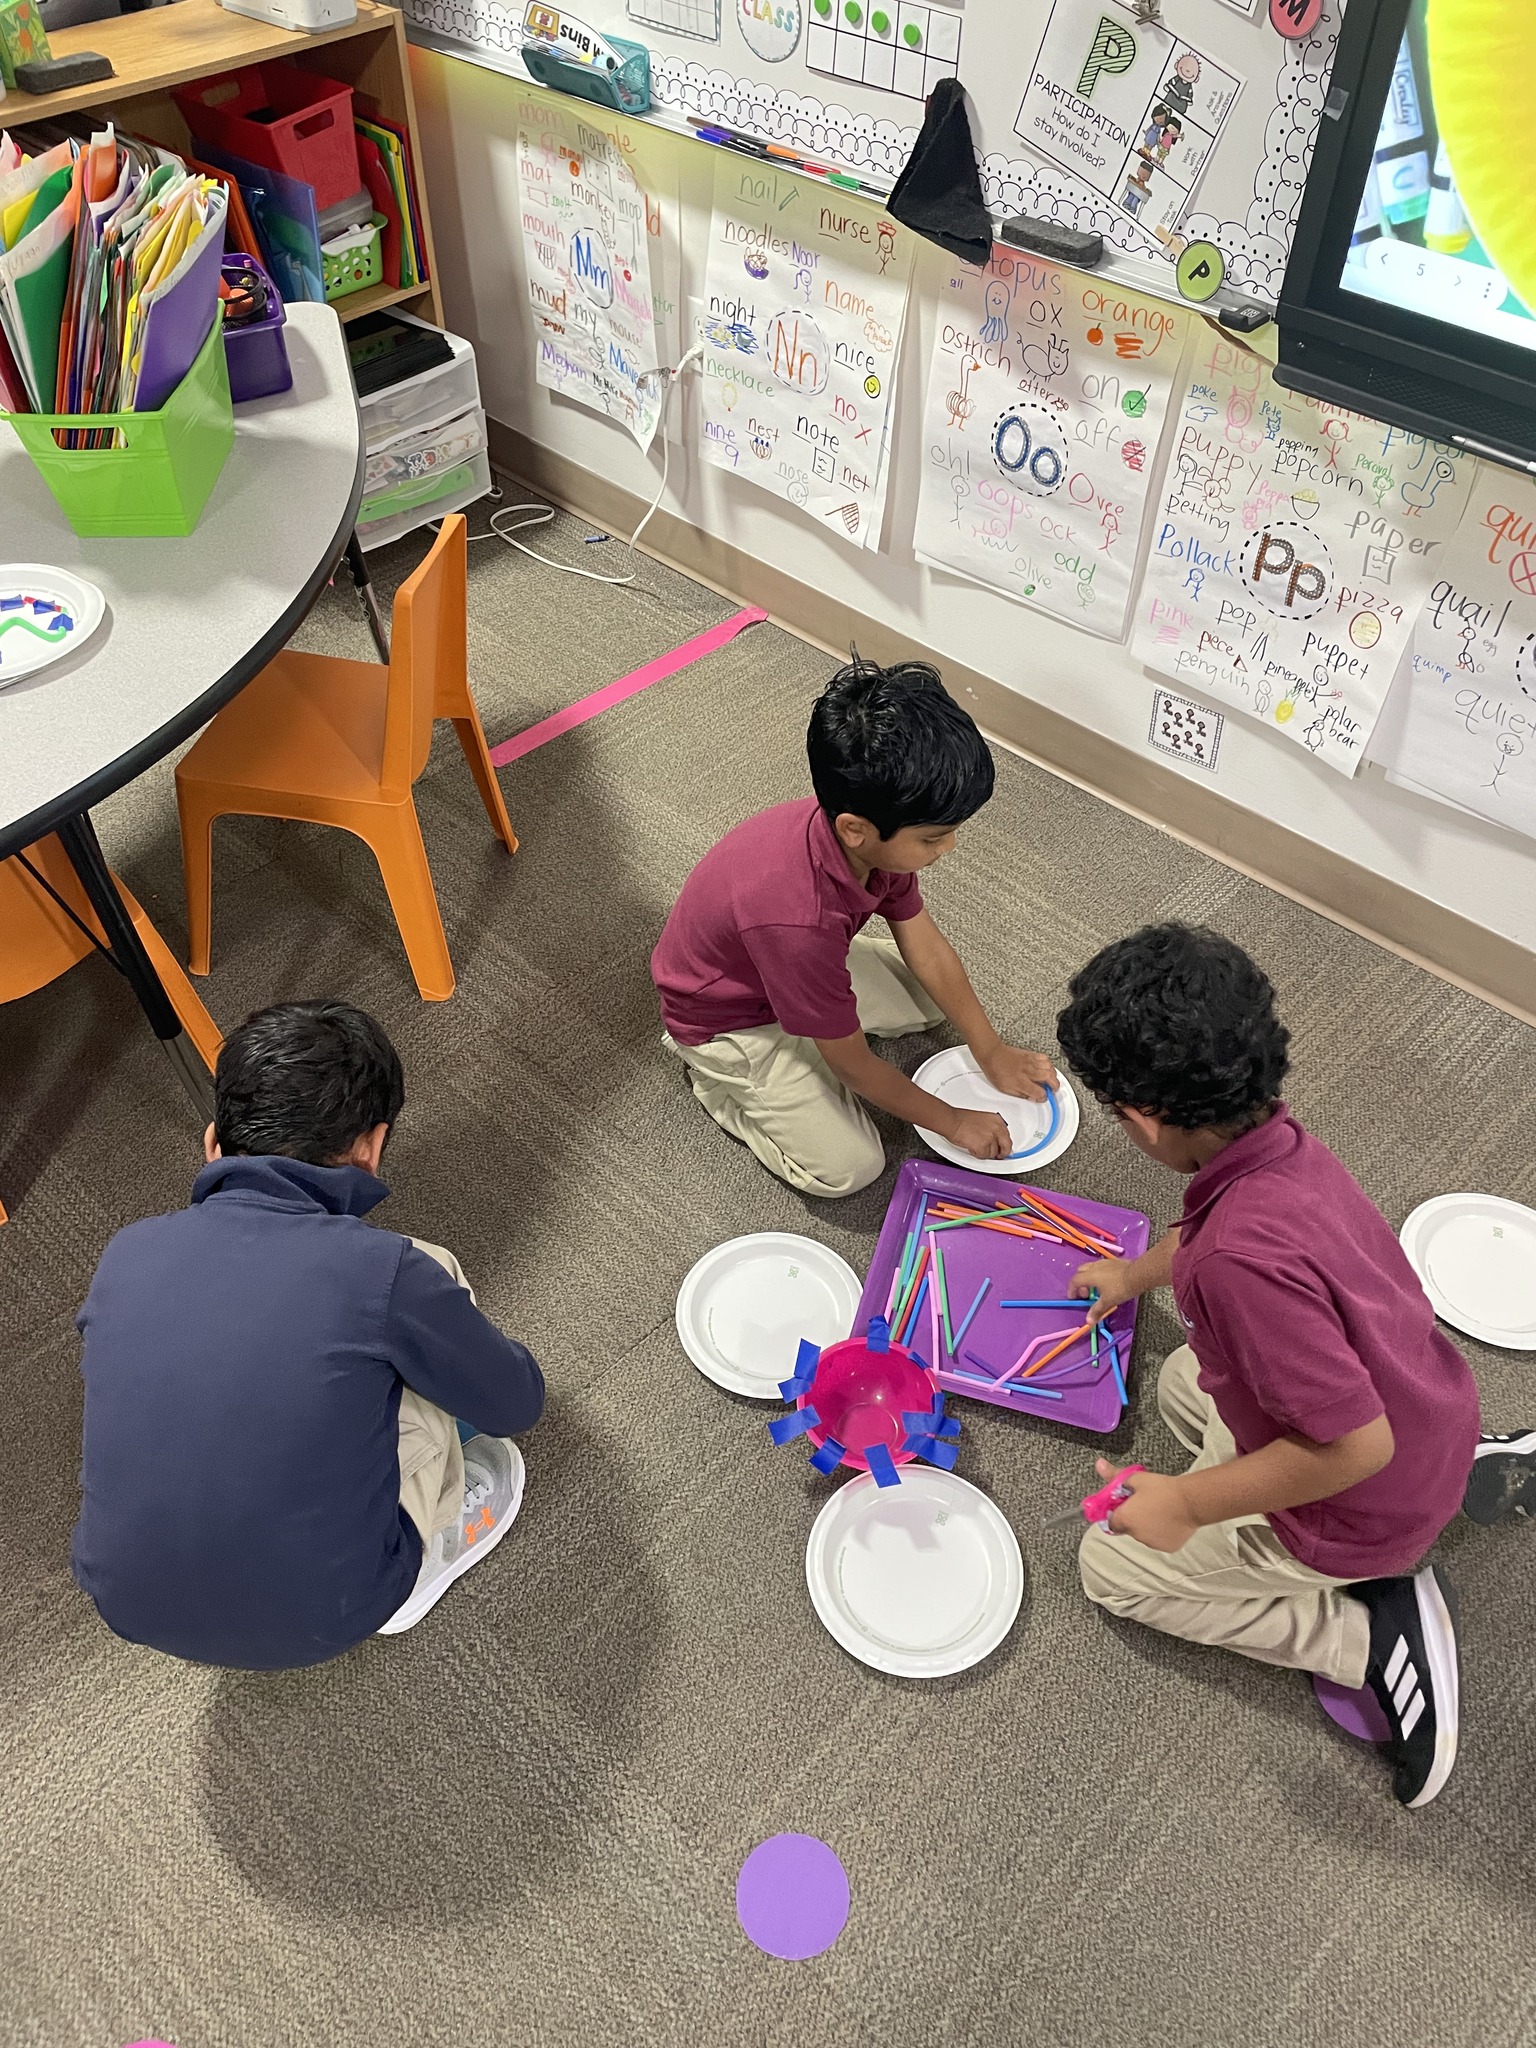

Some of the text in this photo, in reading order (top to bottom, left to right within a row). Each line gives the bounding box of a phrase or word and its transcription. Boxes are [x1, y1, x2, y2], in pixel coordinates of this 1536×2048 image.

[560, 24, 591, 53] Bins
[1077, 16, 1136, 98] P
[1034, 73, 1130, 148] PARTICIPATION
[1052, 106, 1101, 147] How do I
[1034, 116, 1106, 169] stay involved?
[521, 159, 552, 185] mat
[741, 173, 777, 203] nail
[571, 181, 615, 234] monkey
[619, 197, 642, 245] mop
[820, 207, 871, 244] nurse
[523, 213, 565, 249] mouth
[725, 219, 789, 257] noodles
[575, 235, 612, 289] Mm
[792, 241, 821, 268] Noor
[958, 246, 1061, 297] topus
[1188, 259, 1210, 281] P
[1416, 262, 1425, 276] 5
[530, 278, 567, 320] mud
[710, 295, 757, 327] night
[825, 279, 875, 321] name
[1082, 290, 1177, 357] orange
[542, 339, 587, 382] Meghan
[774, 320, 817, 387] Nn
[835, 342, 875, 374] nice
[707, 356, 776, 398] necklace
[1019, 379, 1054, 402] otter
[1082, 374, 1120, 407] on
[1191, 384, 1217, 402] poke
[834, 394, 857, 421] no
[705, 420, 737, 444] nine
[749, 417, 780, 443] nest
[796, 415, 840, 454] note
[1075, 418, 1121, 452] off
[995, 415, 1062, 487] Oo
[1177, 426, 1263, 495] puppy
[1356, 453, 1393, 476] Percival
[779, 460, 809, 484] nose
[843, 465, 870, 492] net
[1275, 450, 1364, 497] popcorn
[978, 480, 1033, 532] oops
[1167, 494, 1230, 543] petting
[1158, 523, 1235, 577] Pollack
[1350, 510, 1442, 556] paper
[1015, 556, 1052, 590] olive
[1055, 552, 1096, 584] odd
[1150, 599, 1195, 630] pink
[1217, 600, 1257, 639] pop
[1337, 587, 1404, 625] pizza
[1430, 580, 1513, 638] quail
[1176, 650, 1249, 695] penguin
[1302, 632, 1369, 680] puppet
[1322, 705, 1362, 733] polar
[1329, 727, 1360, 749] bear
